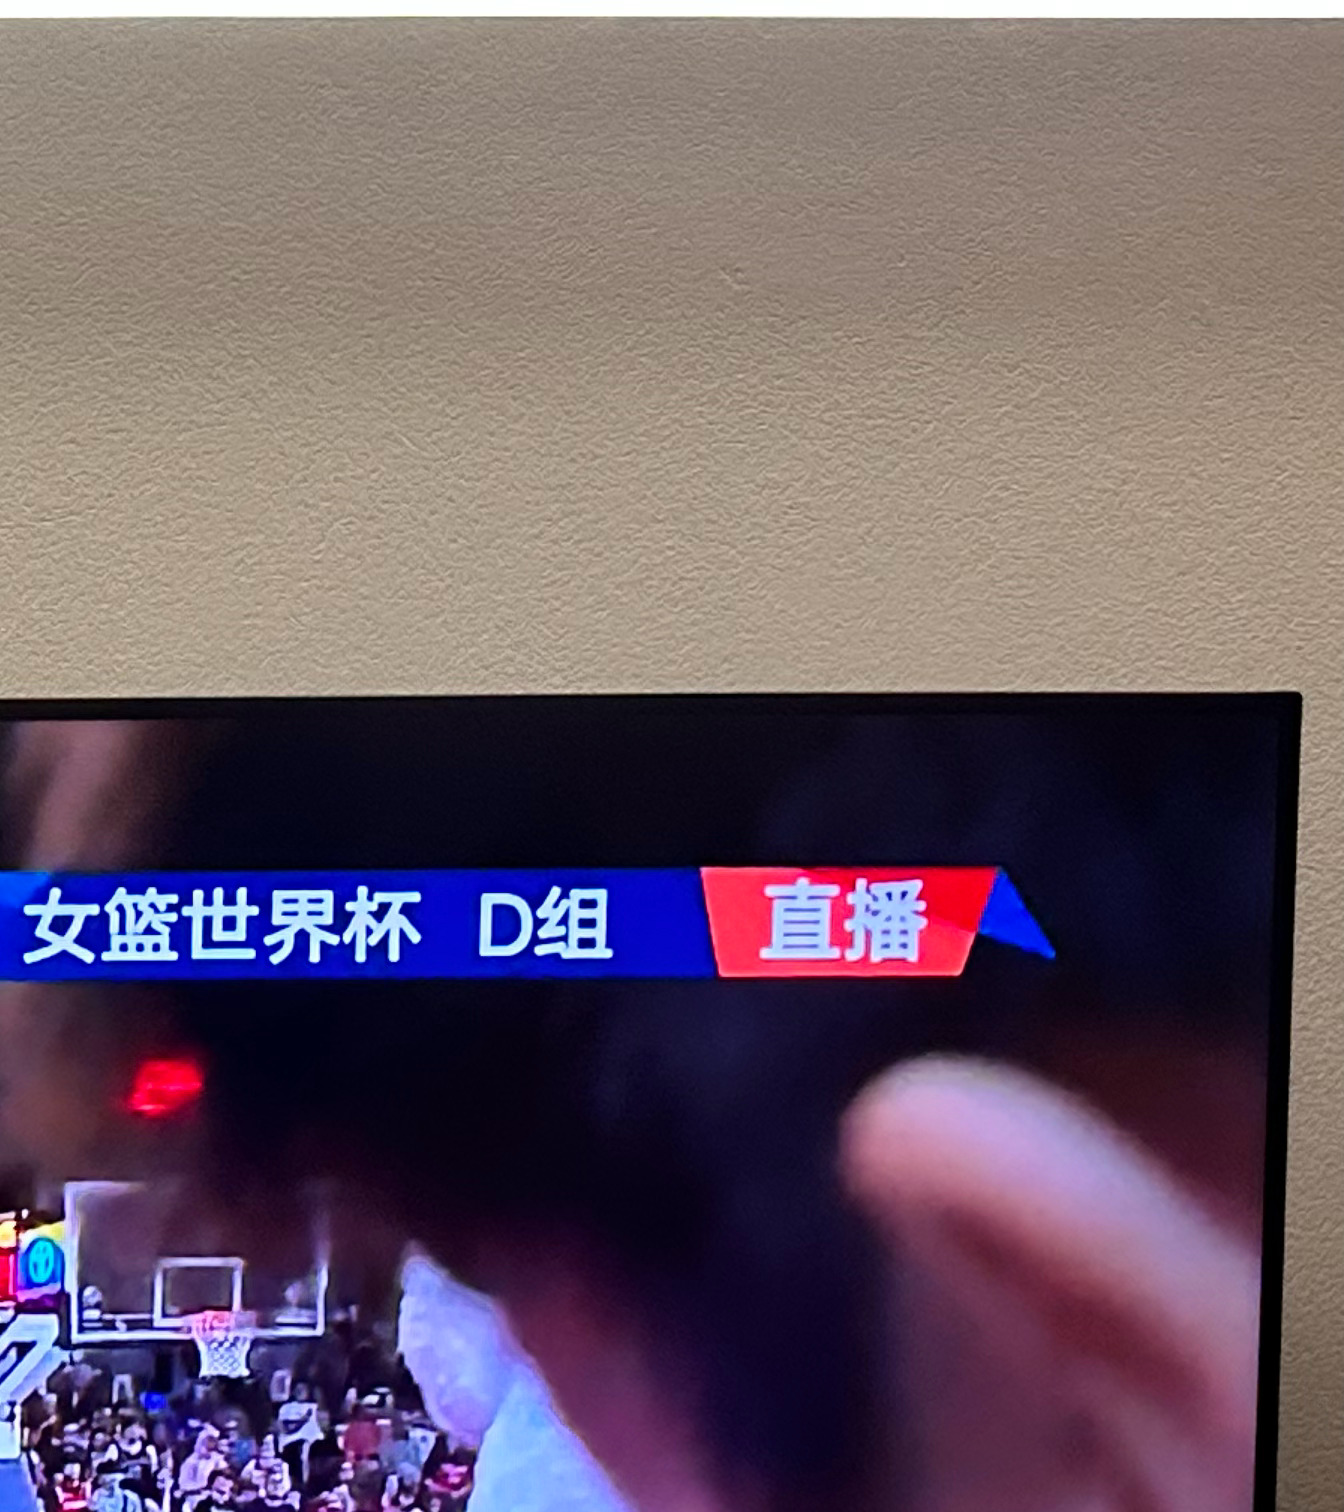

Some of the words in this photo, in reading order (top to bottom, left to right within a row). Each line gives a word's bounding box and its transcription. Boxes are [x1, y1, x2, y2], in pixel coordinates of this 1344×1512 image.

[23, 885, 423, 965] 女篮世界杯
[479, 885, 614, 960] D组
[759, 876, 929, 963] 直播
